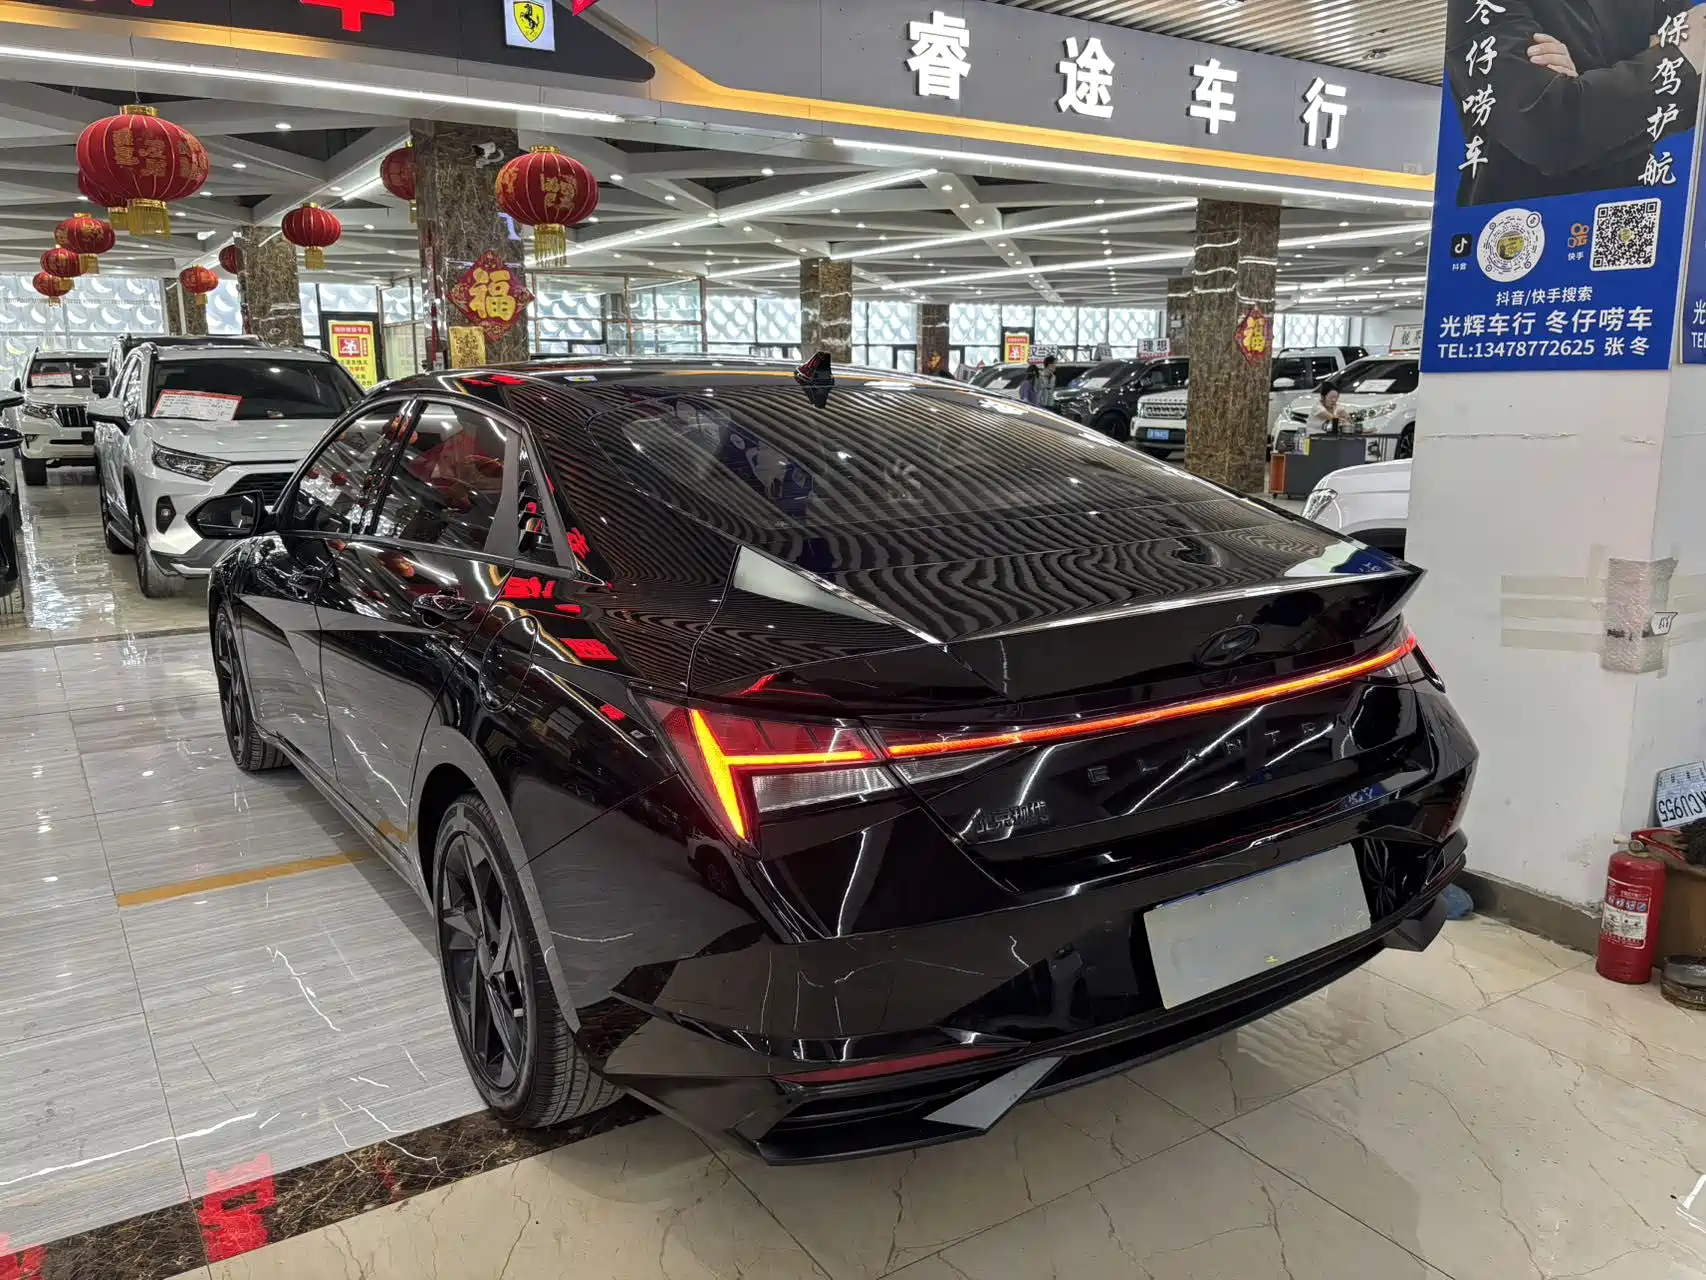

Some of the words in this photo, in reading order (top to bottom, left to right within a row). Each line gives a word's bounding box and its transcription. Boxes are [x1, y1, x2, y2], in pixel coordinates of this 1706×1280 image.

[905, 10, 1347, 150] 睿途车行
[1637, 11, 1689, 186] 保驾护航
[1452, 262, 1468, 271] 抖音
[1567, 252, 1584, 261] 快手
[468, 267, 517, 321] 福
[1495, 286, 1593, 307] 抖音/快手搜索
[1439, 311, 1536, 338] 光辉车行
[1545, 306, 1653, 334] 冬仔唠车
[1437, 339, 1595, 359] TEL:13478772625
[1604, 337, 1650, 356] 张冬
